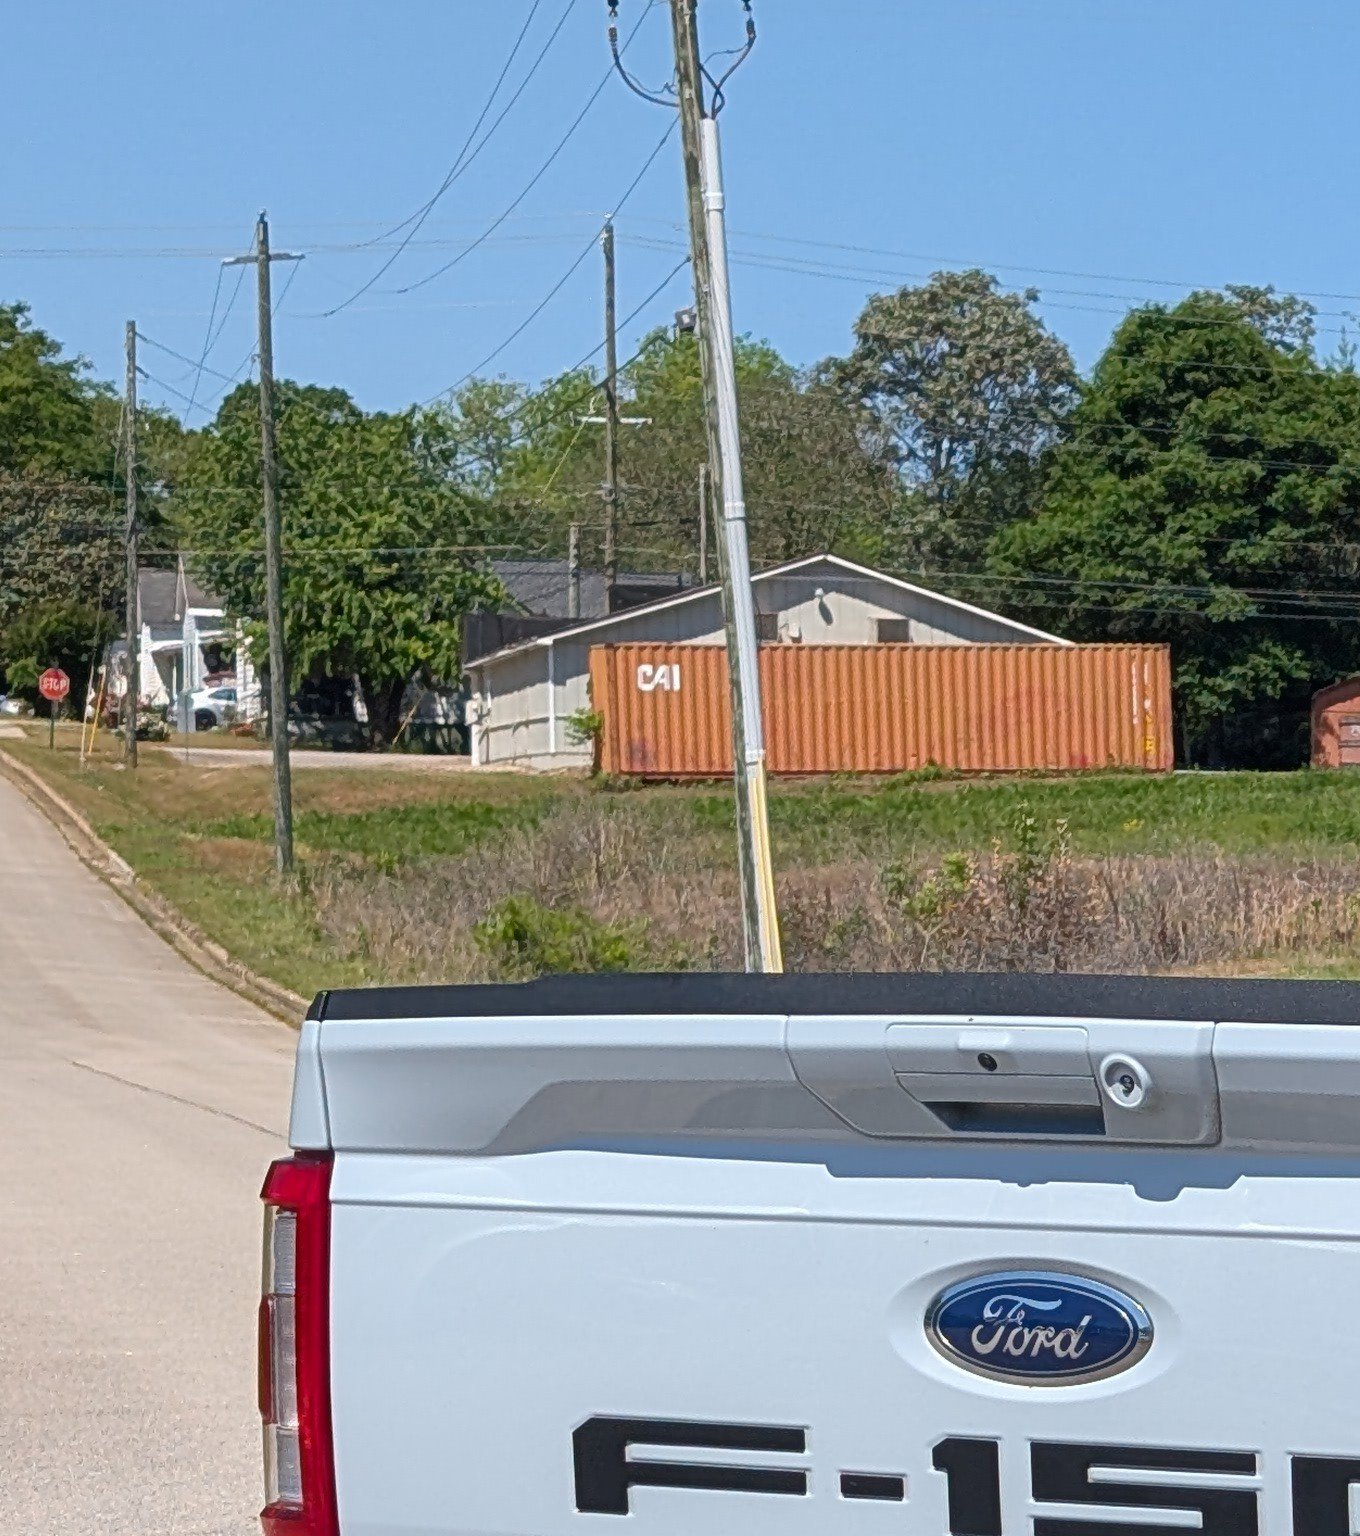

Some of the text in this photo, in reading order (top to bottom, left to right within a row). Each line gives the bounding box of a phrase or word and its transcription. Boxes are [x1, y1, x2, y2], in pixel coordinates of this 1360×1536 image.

[41, 677, 67, 691] STOP
[637, 664, 681, 692] CAI
[971, 1294, 1092, 1359] Ford
